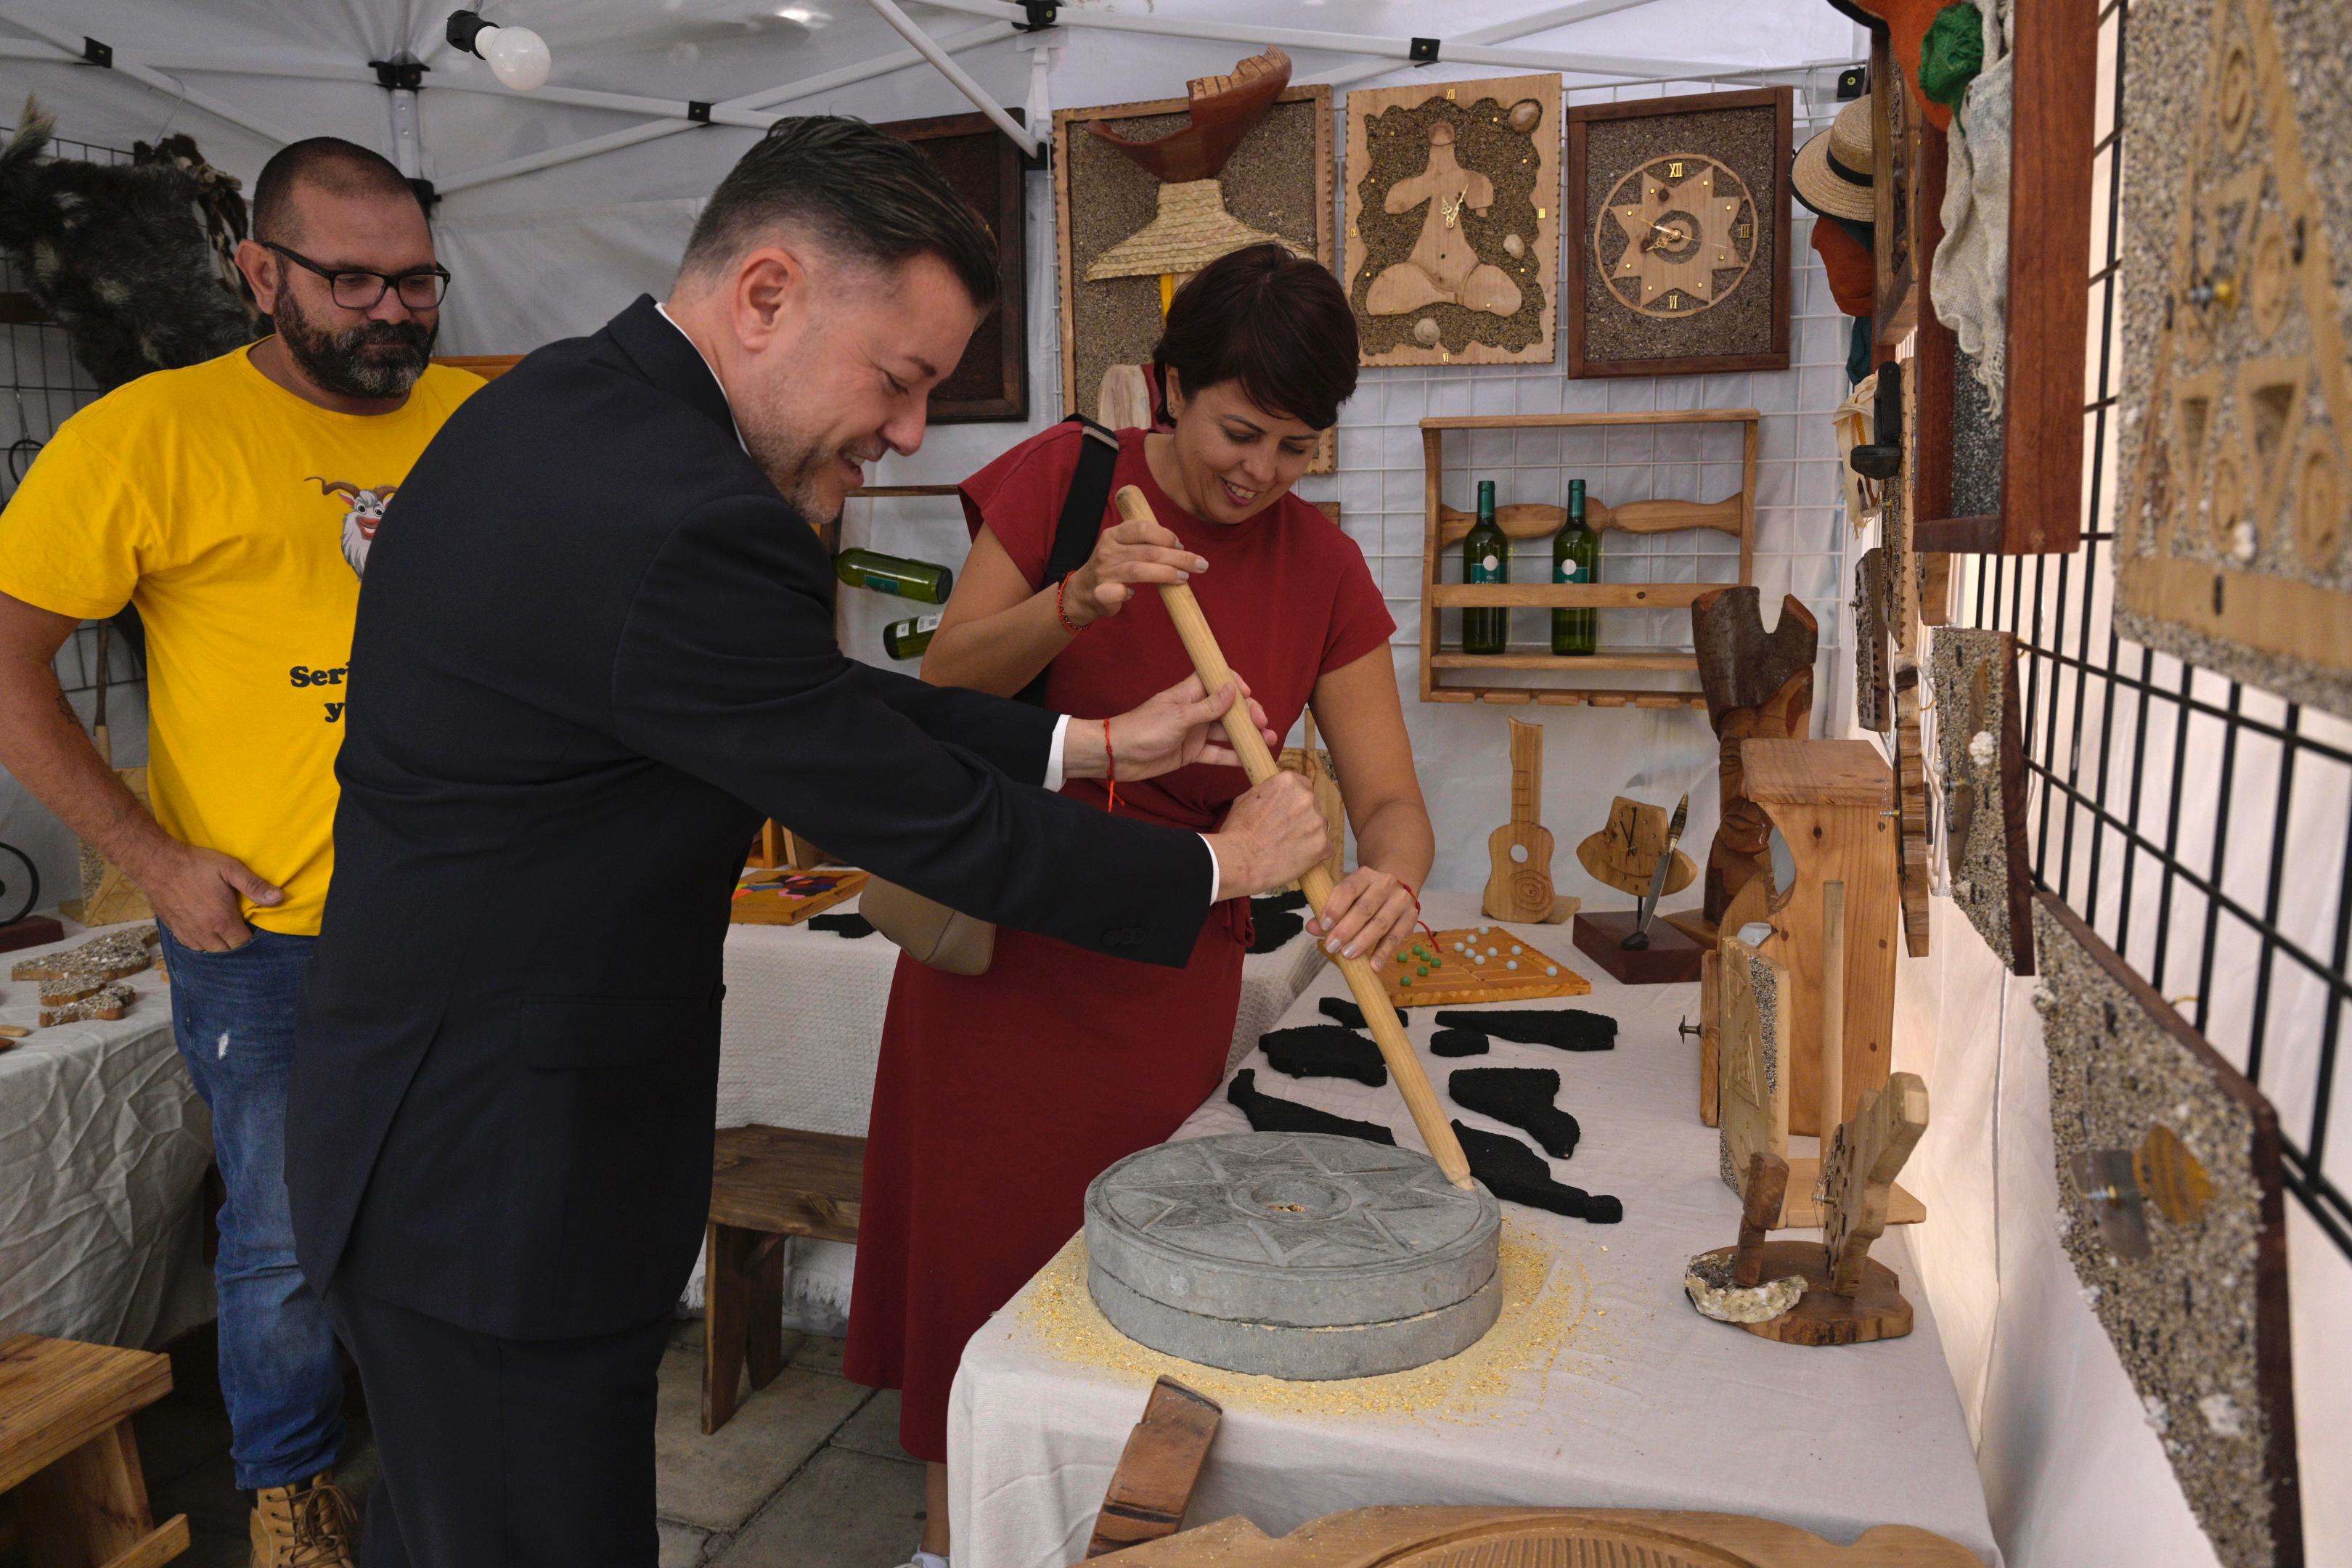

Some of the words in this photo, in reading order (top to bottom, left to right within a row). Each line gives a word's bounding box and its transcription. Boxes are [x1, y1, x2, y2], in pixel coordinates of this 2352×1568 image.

[1446, 89, 1455, 100] XII
[1669, 162, 1683, 179] XII
[1350, 226, 1357, 238] IX
[1739, 224, 1750, 239] III
[1669, 295, 1678, 310] VI
[1442, 352, 1449, 362] VI
